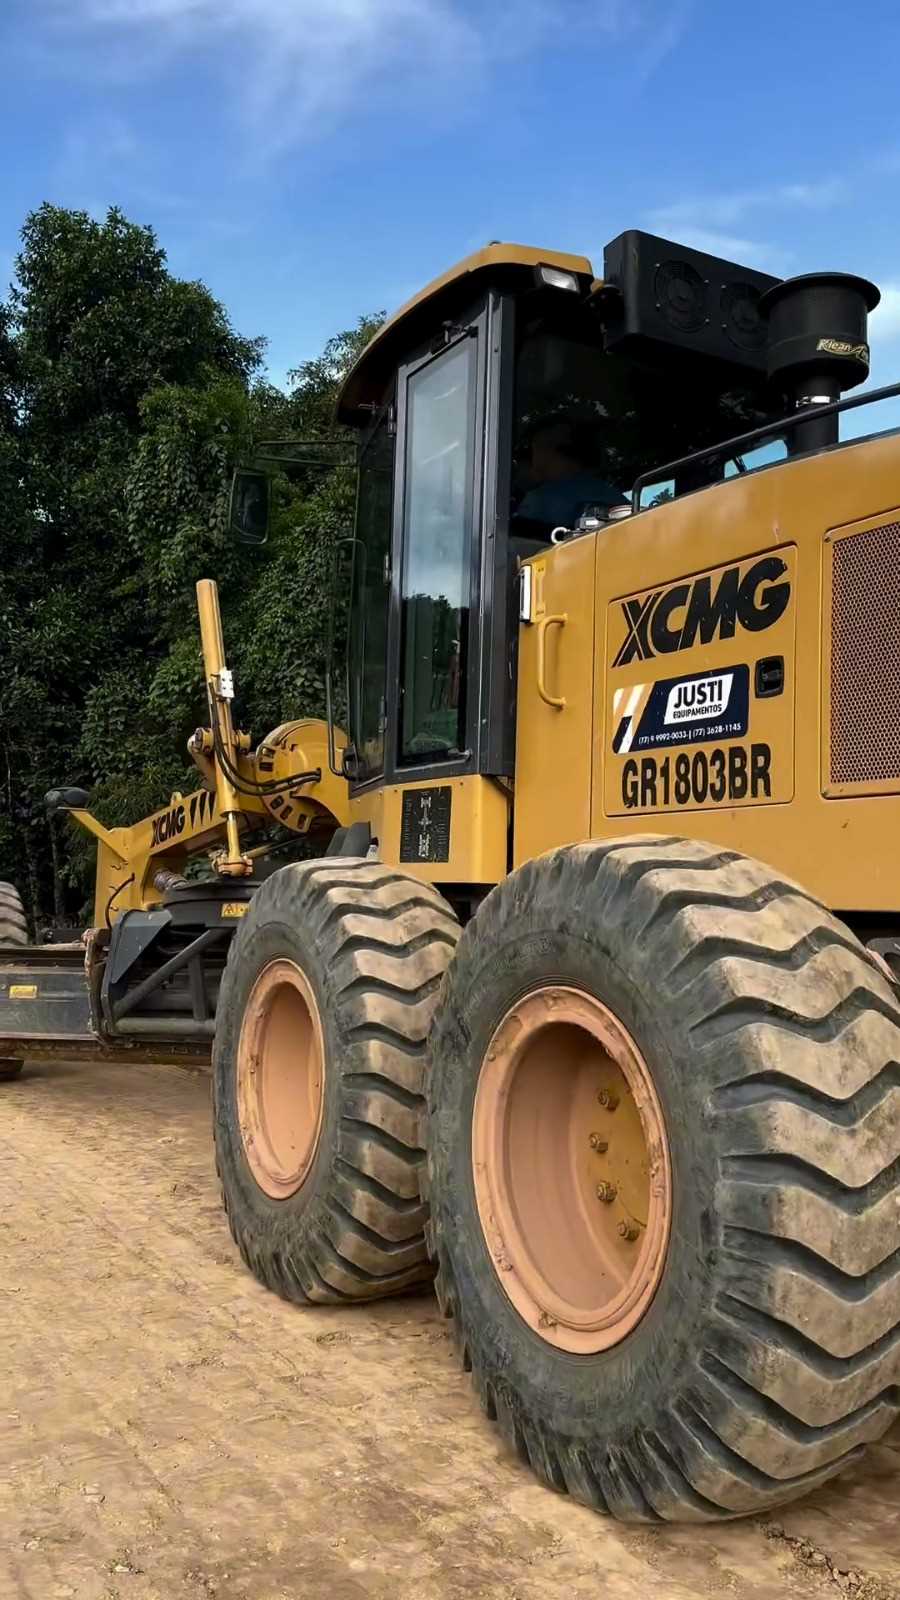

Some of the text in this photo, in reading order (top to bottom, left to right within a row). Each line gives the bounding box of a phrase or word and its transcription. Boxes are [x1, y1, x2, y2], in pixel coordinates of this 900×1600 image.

[611, 557, 790, 668] XCMG
[673, 704, 722, 719] EQUIPAMENTOS
[674, 680, 722, 708] JUSTI
[706, 722, 742, 735] 3628-1145
[622, 743, 771, 808] GR1803BR
[150, 806, 185, 848] XCMG
